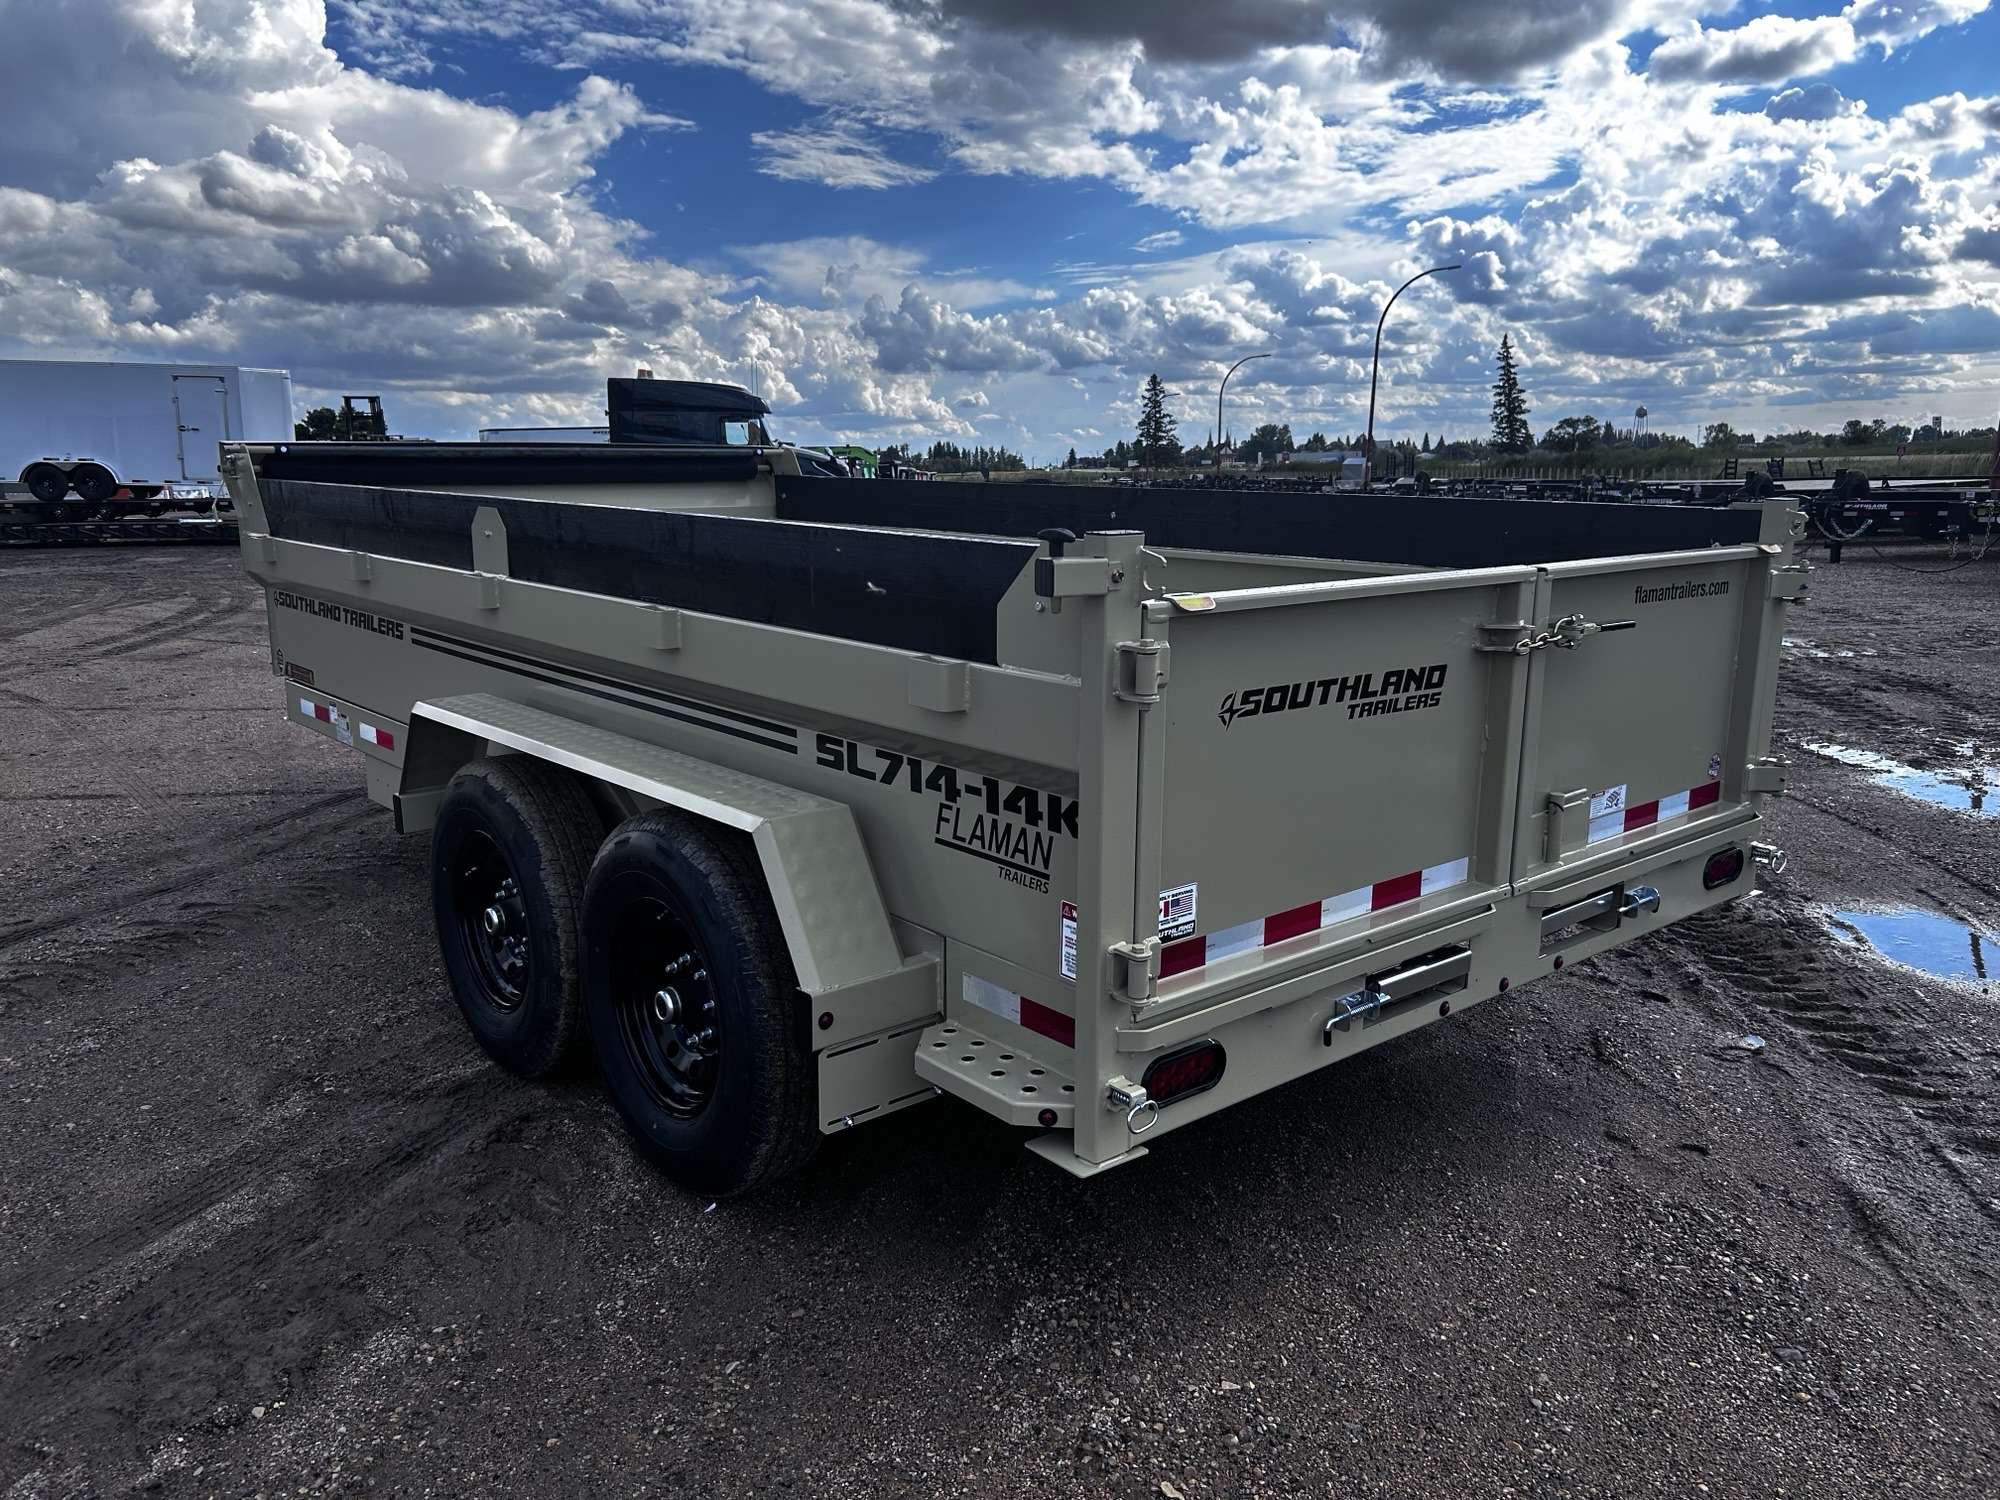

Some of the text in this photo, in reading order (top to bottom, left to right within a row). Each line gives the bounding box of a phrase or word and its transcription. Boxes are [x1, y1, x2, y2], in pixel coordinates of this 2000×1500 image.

[1635, 581, 1729, 604] flamantrailers.com
[278, 591, 404, 640] SOUTHLAND TRAILERS
[1237, 664, 1447, 718] SOUTHLAND
[1348, 692, 1441, 720] TRAILERS
[816, 733, 1079, 839] SL714-14K
[935, 802, 1054, 871] FLAMAN
[998, 866, 1050, 894] TRAILERS
[1159, 923, 1194, 938] UTHLAND
